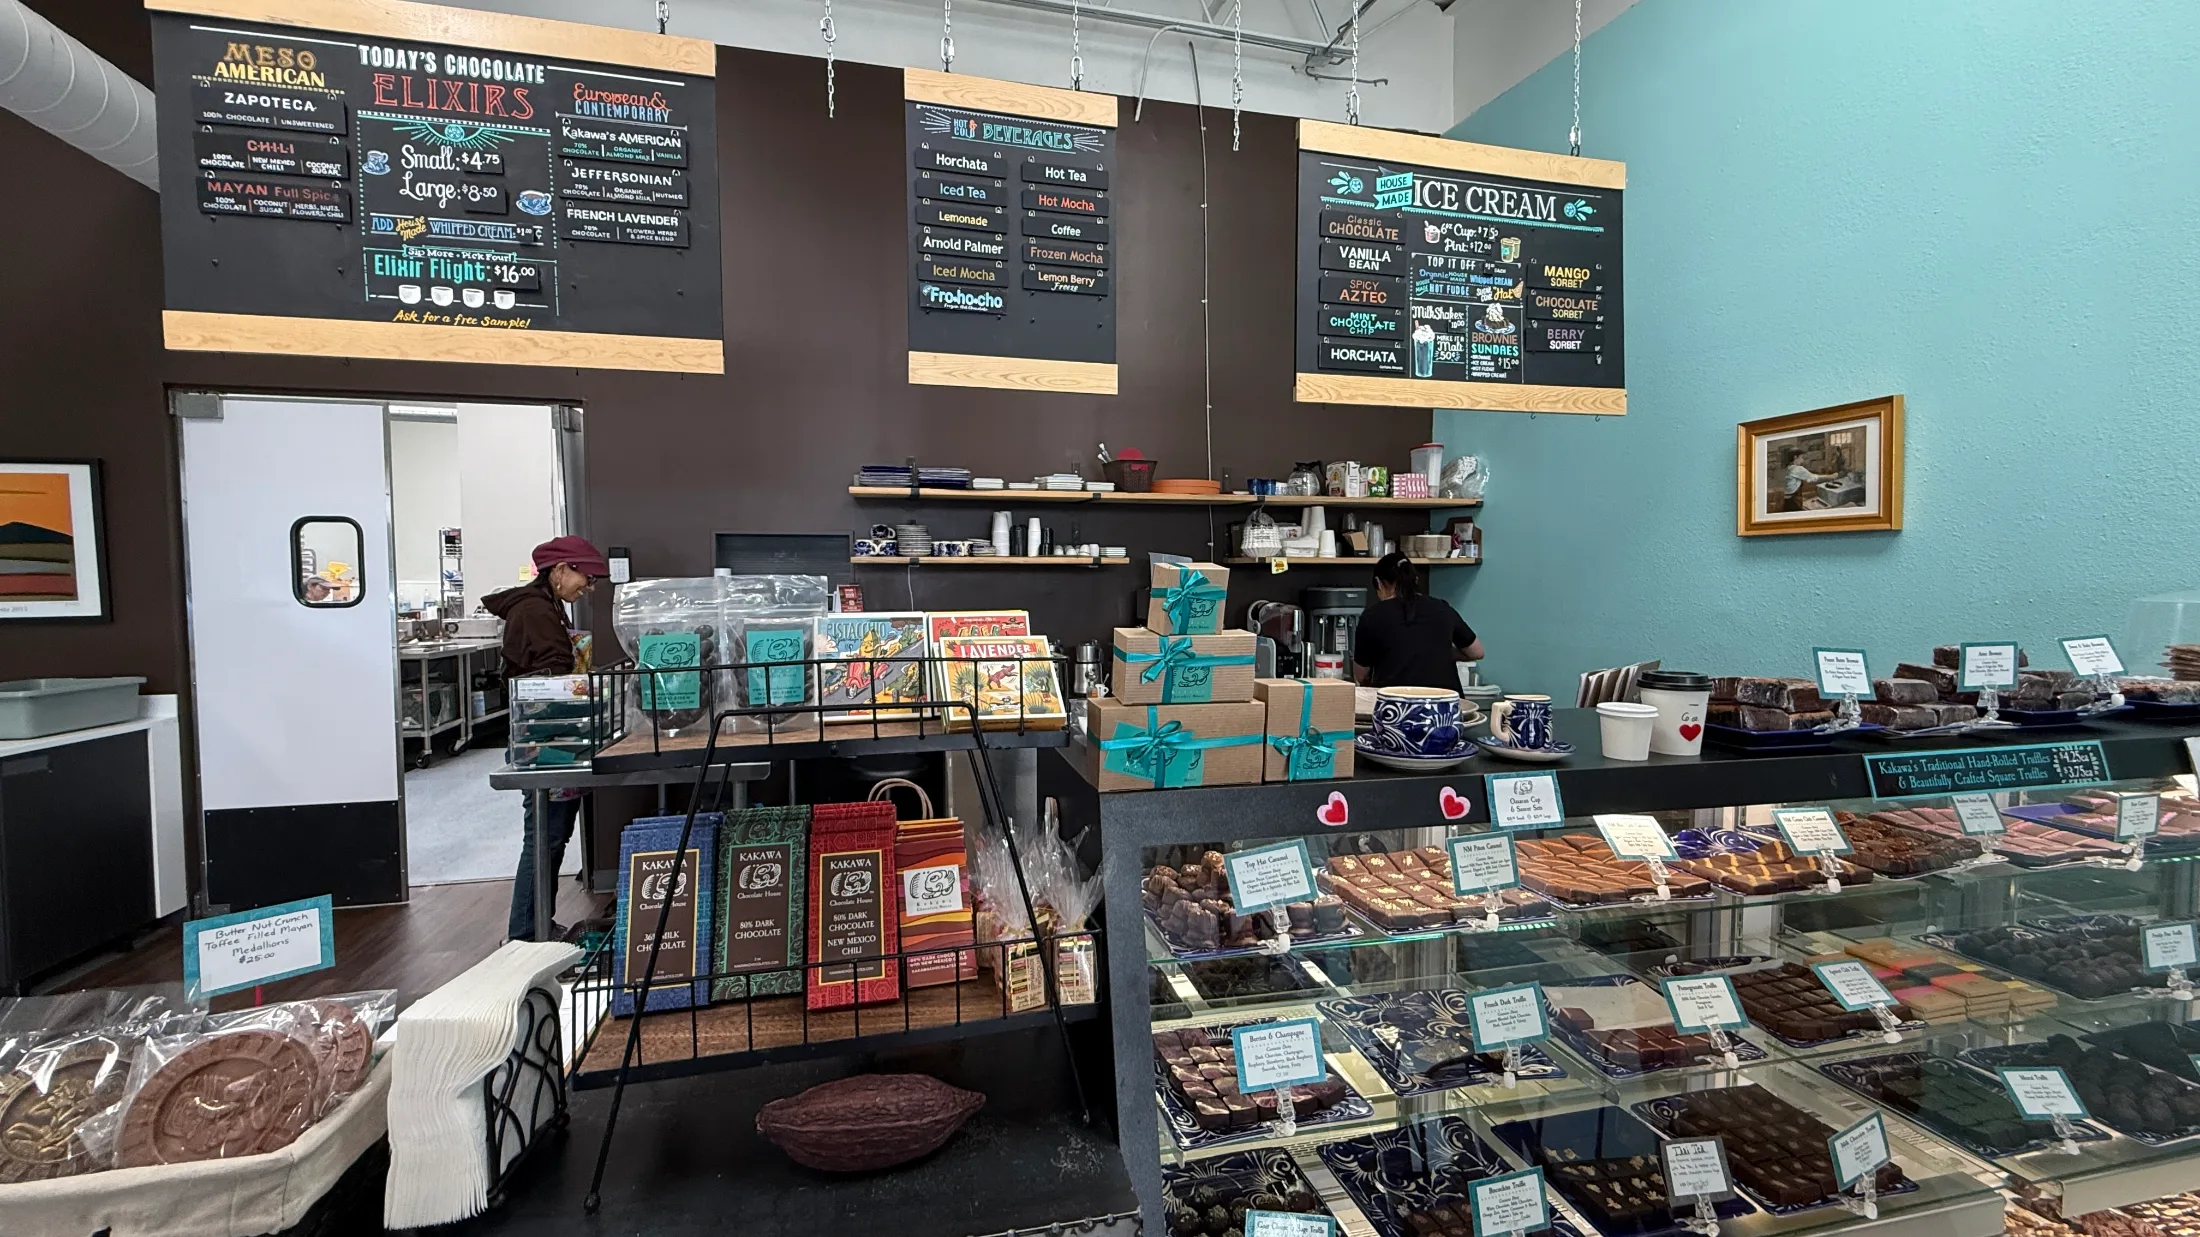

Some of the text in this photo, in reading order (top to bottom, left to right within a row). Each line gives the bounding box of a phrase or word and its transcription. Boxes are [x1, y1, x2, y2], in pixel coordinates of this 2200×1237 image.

[223, 42, 317, 71] MESO
[358, 45, 545, 84] TODAY'S CHOCOLATE
[214, 62, 325, 88] AMERICAN
[224, 92, 317, 112] ZAPOTECA
[373, 73, 534, 120] ELIXIRS
[573, 82, 651, 107] European
[226, 113, 270, 125] CHOCOLATE
[575, 99, 670, 124] CONTEMPORARY
[281, 118, 335, 130] UNSWEETENED
[953, 119, 968, 129] HOT
[562, 126, 681, 148] Kakawa's AMERICAN
[953, 127, 976, 138] COLD
[983, 123, 1073, 150] BEVERAGES
[563, 147, 600, 156] CHOCOLATE
[656, 152, 682, 160] VANILLA
[201, 158, 245, 169] CHOCOLATE
[461, 151, 500, 170] $4.75
[936, 153, 988, 171] Horchata
[571, 168, 672, 186] JEFFERSONIAN
[1045, 167, 1087, 182] Hot Tea
[207, 181, 299, 199] MAYAN Full
[1380, 176, 1408, 190] HOUSE
[462, 185, 498, 202] $8.50
[563, 189, 601, 197] CHOCOLATE
[939, 183, 986, 199] Iced Tea
[203, 202, 247, 212] CHOCOLATE
[1038, 195, 1095, 211] Hot Mocha
[1382, 192, 1409, 207] MADE
[1413, 179, 1558, 222] ICE CREAM
[371, 217, 394, 232] ADD
[396, 216, 425, 232] House
[567, 208, 679, 227] FRENCH LAVENDER
[939, 211, 989, 227] Lemonade
[1347, 215, 1382, 227] Classic
[429, 221, 475, 236] WHIPPED
[572, 230, 611, 239] CHOCOLATE
[1051, 224, 1082, 237] Coffee
[1329, 222, 1399, 241] CHOCOLATE
[923, 236, 1004, 255] Arnold Palmer
[408, 249, 425, 258] Sip
[427, 250, 454, 258] More
[462, 252, 485, 261] Pick
[1030, 246, 1104, 264] Frozen Mocha
[1339, 246, 1392, 263] VANILLA
[374, 254, 424, 278] Elixir
[494, 265, 535, 284] $16.00
[1348, 258, 1380, 271] BEAN
[1427, 256, 1476, 271] TOP IT OFF
[933, 264, 996, 282] Iced Mocha
[1038, 271, 1096, 288] Lemon Berry
[1419, 269, 1449, 280] Organic
[1544, 265, 1591, 281] MANGO
[1051, 282, 1079, 293] Freeze
[1350, 279, 1380, 290] SPICY
[1494, 277, 1513, 287] CREAM
[1551, 278, 1584, 289] SORBET
[1339, 289, 1387, 304] AZTEC
[1430, 284, 1470, 296] HOT FUDGE
[1536, 295, 1599, 311] CHOCOLATE
[393, 310, 420, 323] Ask
[422, 311, 440, 324] for
[454, 313, 477, 326] free
[481, 315, 531, 330] Sample!
[1350, 312, 1377, 321] MINT
[1552, 308, 1584, 320] SORBET
[1330, 317, 1396, 331] CHOCOLATE
[1349, 327, 1375, 336] CHIP
[1472, 332, 1518, 345] BROWNIE
[1547, 328, 1586, 340] BERRY
[1438, 340, 1465, 352] Malt
[1471, 344, 1519, 357] SUNDAES
[1549, 340, 1582, 350] SORBET
[1330, 348, 1397, 364] HORCHATA
[960, 644, 1031, 659] LAVENDER
[1878, 759, 1919, 775] Kakawa's
[1922, 755, 1966, 773] Traditional
[1968, 753, 2018, 770] Hand-Rolled
[2019, 751, 2051, 765] Truffles
[1909, 771, 1953, 790] Beautifully
[1954, 769, 1985, 786] Crafted
[1987, 769, 2017, 786] Square
[2018, 766, 2049, 780] Truffles
[1530, 796, 1541, 804] Cup
[1486, 842, 1502, 850] Caramel
[739, 850, 782, 862] KAKAWA
[1245, 861, 1255, 869] Top
[1267, 854, 1289, 864] Caramel
[830, 858, 872, 870] KAKAWA
[737, 890, 782, 900] Chocolate House
[833, 911, 868, 921] 80% DARK
[215, 913, 309, 940] Butter Nut Crunch
[247, 930, 276, 941] Filled
[280, 922, 313, 935] Mayan
[740, 919, 775, 929] 80% DARK
[829, 920, 875, 932] CHOCOLATE
[735, 928, 782, 940] CHOCOLATE
[827, 935, 877, 947] NEW MEXICO
[232, 938, 290, 957] Medallions
[842, 946, 862, 956] CHILI
[1275, 1030, 1305, 1038] Champagne
